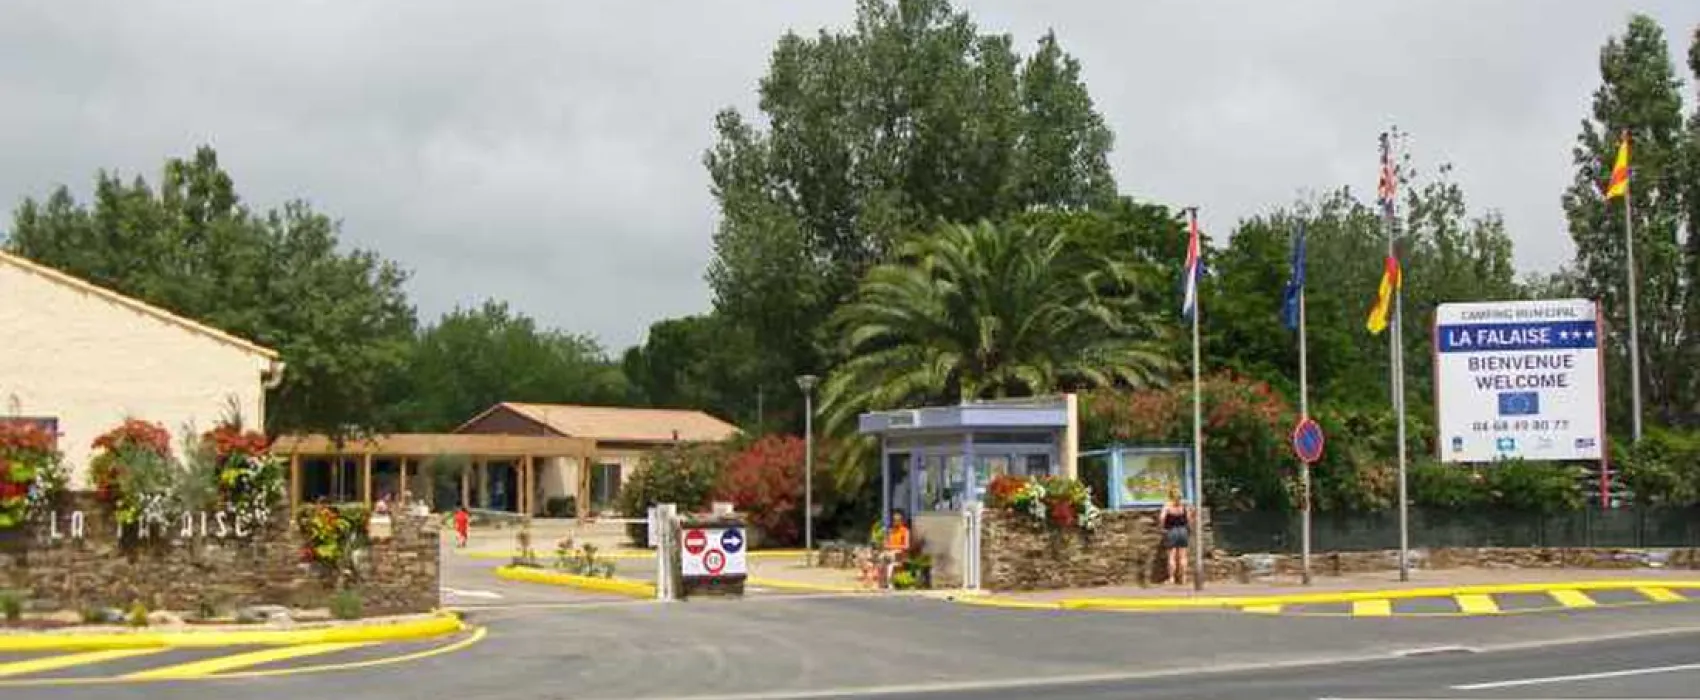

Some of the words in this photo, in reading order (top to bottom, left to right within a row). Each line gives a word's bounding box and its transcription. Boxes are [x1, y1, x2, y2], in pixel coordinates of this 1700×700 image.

[1449, 330, 1472, 347] LA
[1477, 327, 1550, 345] FALAISE
[1468, 354, 1573, 371] BIENVENUE
[1476, 373, 1568, 390] WELCOME
[50, 510, 84, 539] LA
